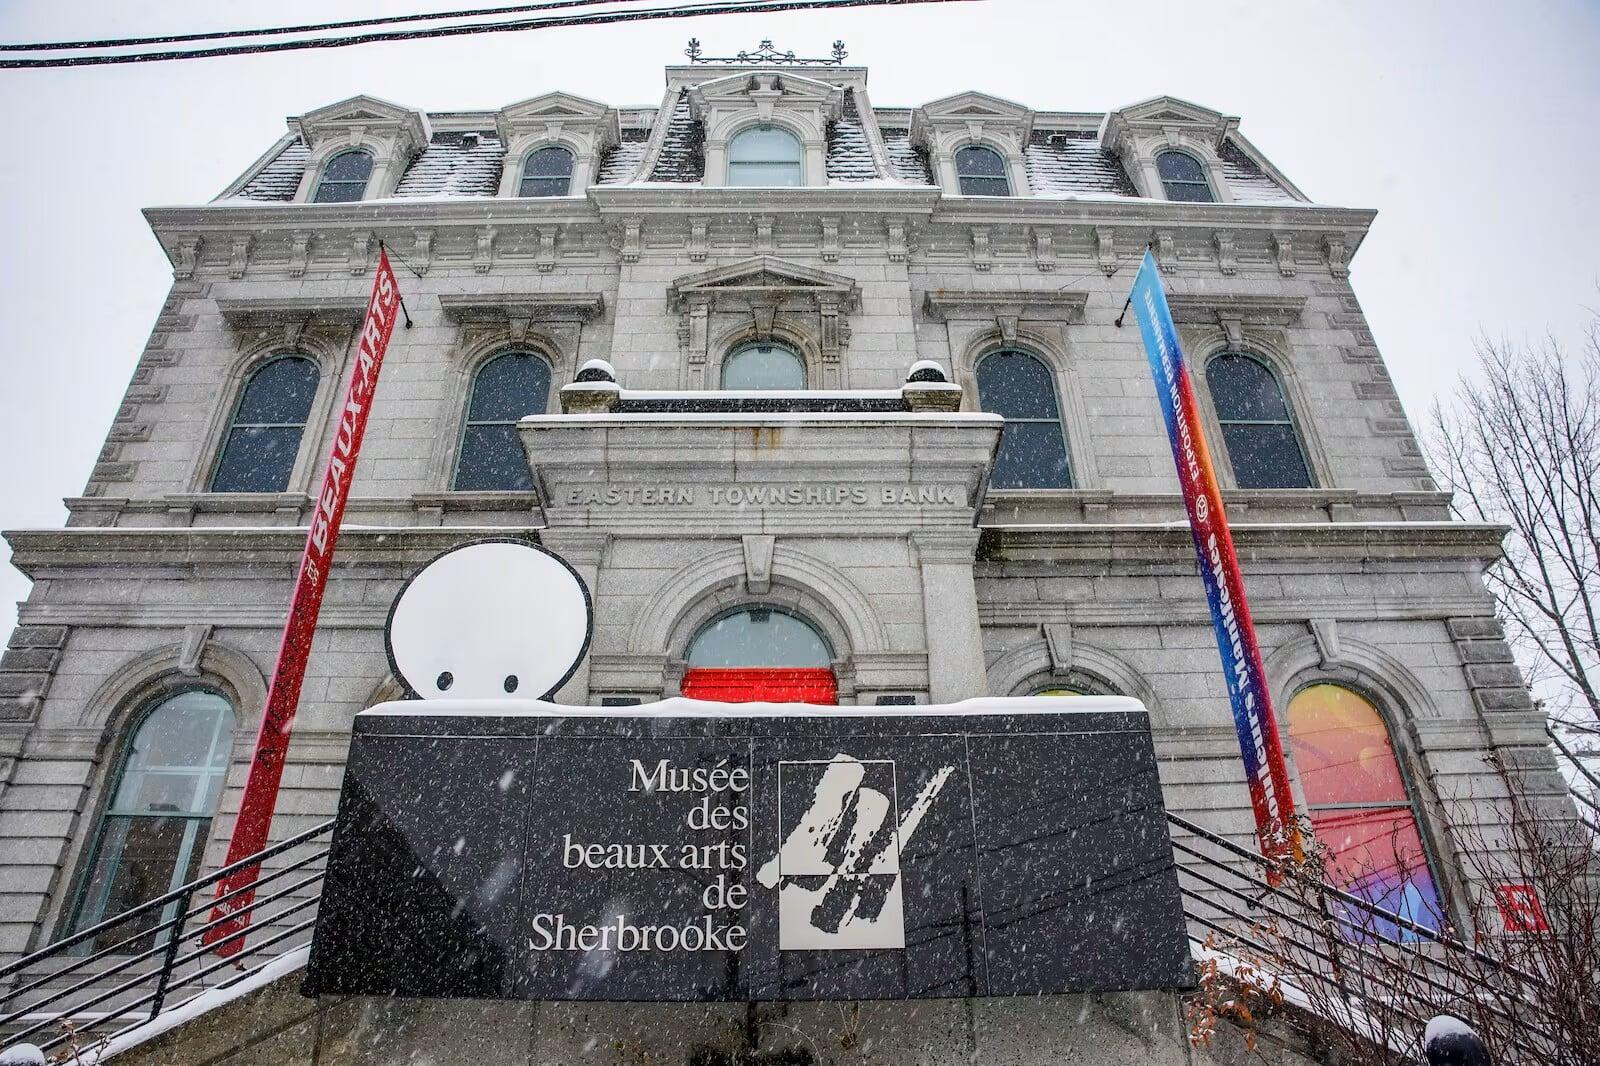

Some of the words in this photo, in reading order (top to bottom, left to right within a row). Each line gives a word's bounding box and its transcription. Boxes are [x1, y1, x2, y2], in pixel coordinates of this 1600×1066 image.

[1144, 288, 1174, 384] PERMANENTE
[311, 270, 393, 557] BEAUX-ARTS
[1169, 381, 1200, 482] EXPOSITION
[567, 487, 694, 506] EASTERN
[708, 486, 868, 506] TOWNSHIPS
[883, 486, 955, 505] BANK
[1207, 533, 1251, 690] Manifestes
[627, 758, 749, 793] Musée
[1246, 691, 1283, 840] Couleurs
[687, 798, 748, 830] des
[562, 834, 670, 869] beaux
[679, 840, 747, 869] arts
[701, 875, 748, 909] de
[529, 913, 748, 952] Sherbrooke
